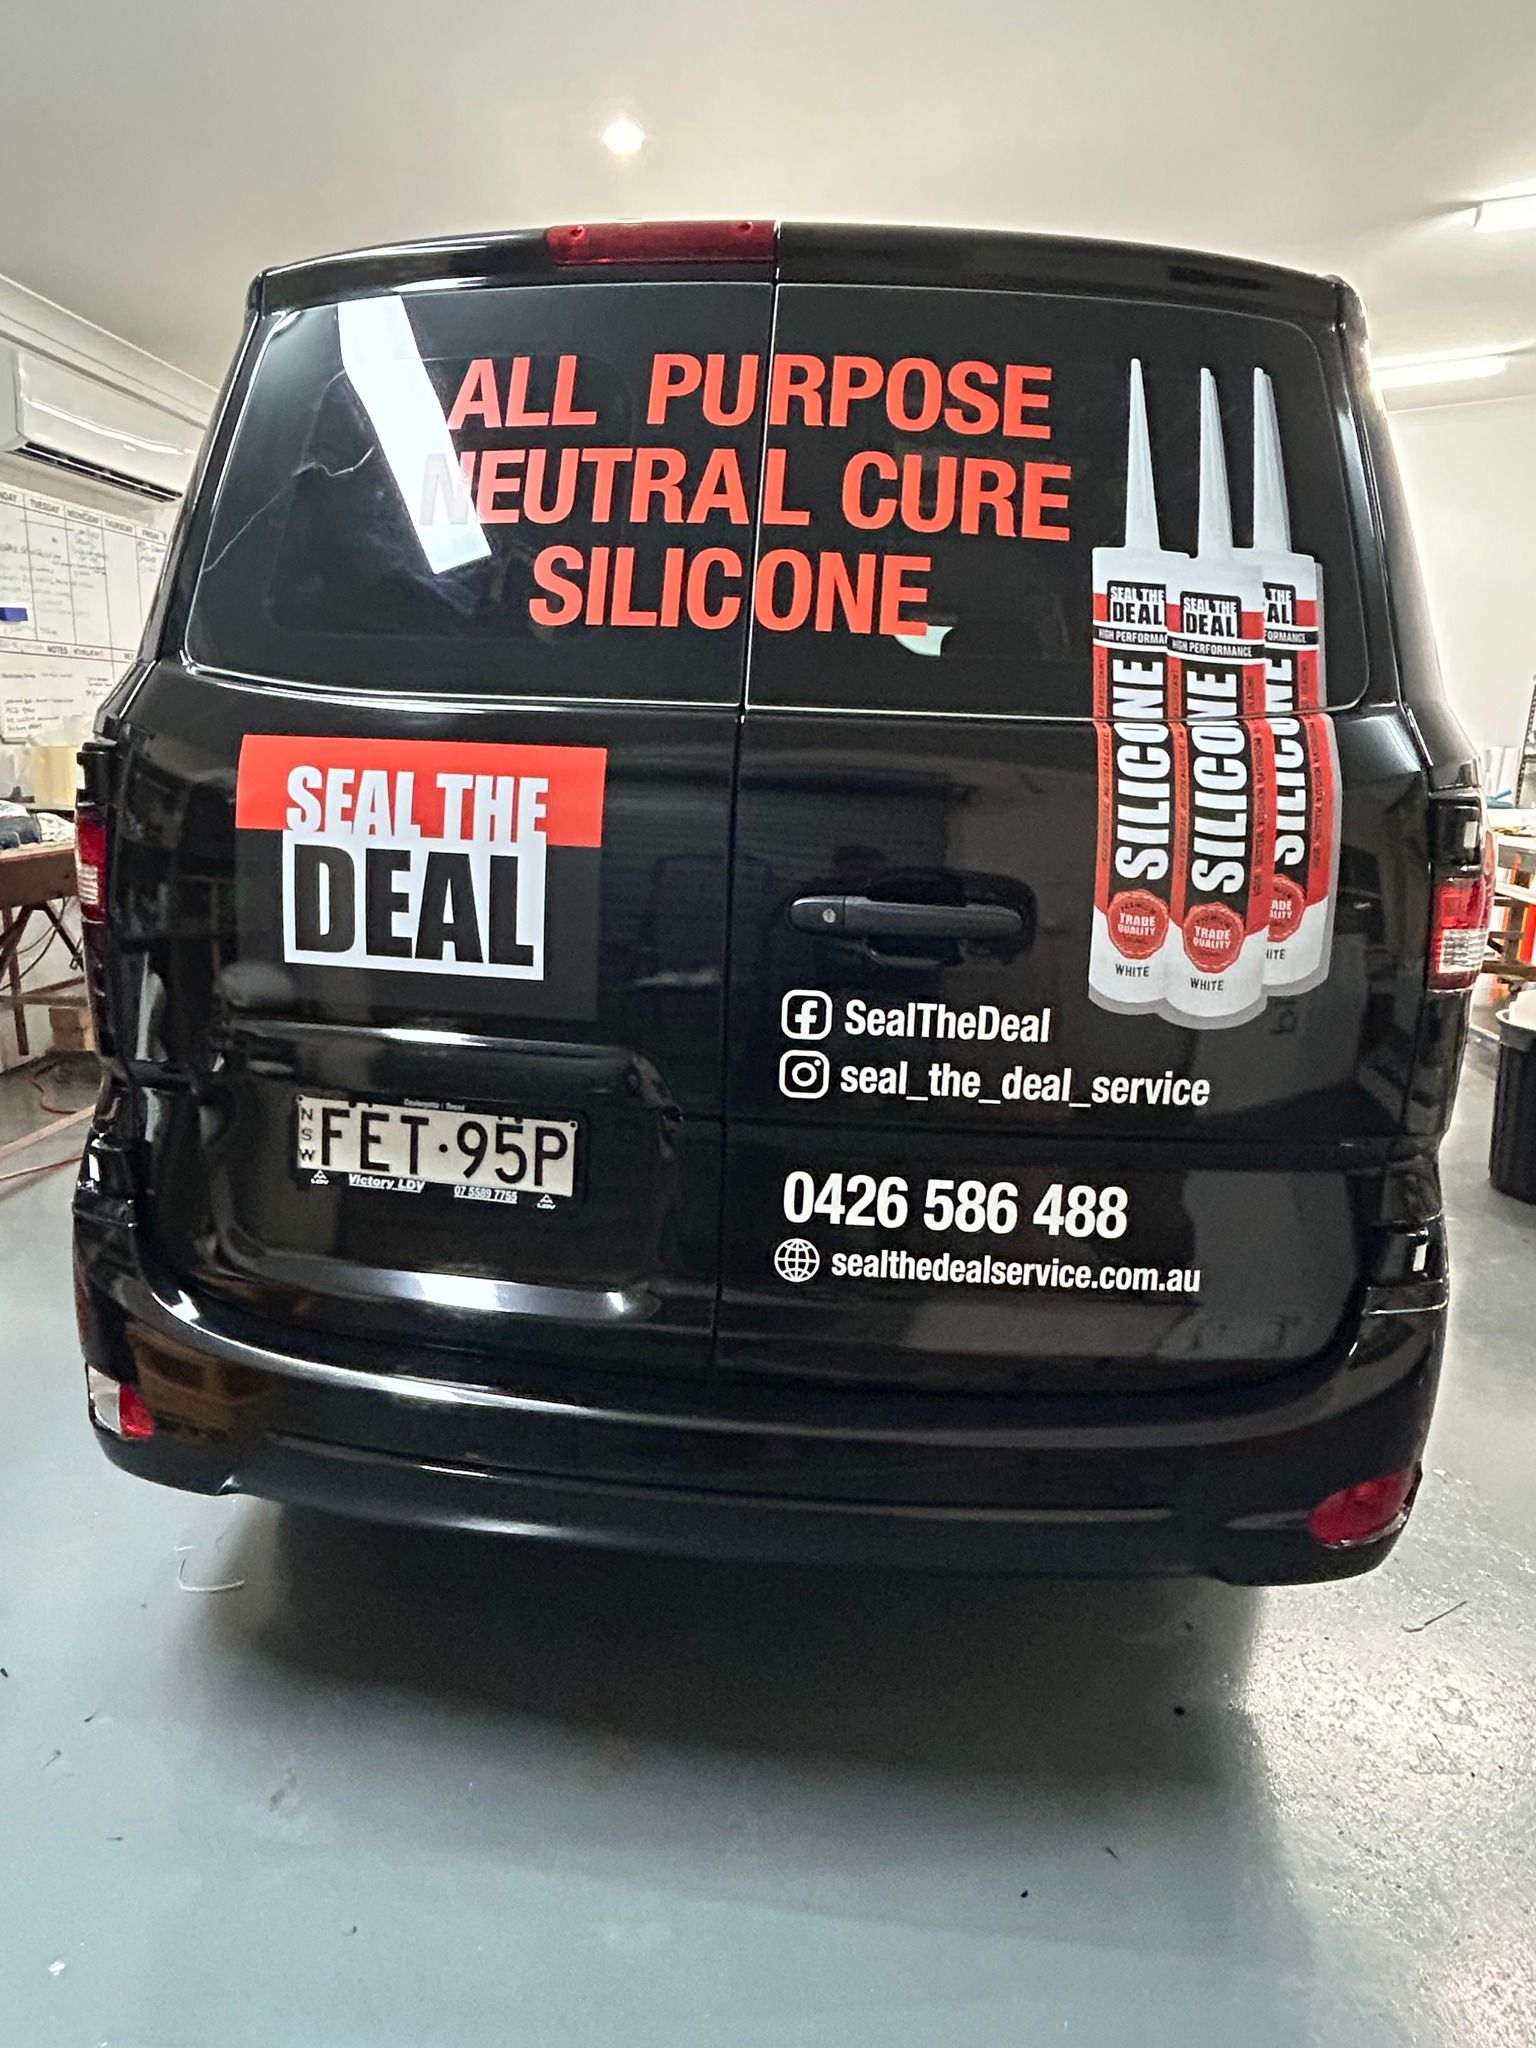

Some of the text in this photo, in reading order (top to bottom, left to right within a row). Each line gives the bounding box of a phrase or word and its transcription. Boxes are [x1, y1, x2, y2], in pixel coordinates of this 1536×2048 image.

[447, 353, 1053, 440] ALL PURPOSE
[419, 448, 1072, 542] NEUTRAL CURE
[529, 544, 932, 637] SILICONE
[1111, 585, 1165, 604] SEAL THE
[1269, 588, 1292, 603] THE
[1112, 601, 1163, 625] DEAL
[1183, 596, 1237, 614] SEAL THE
[1267, 603, 1290, 624] AL
[1099, 628, 1115, 640] HIGH
[1185, 613, 1235, 637] DEAL
[1264, 631, 1306, 644] FORMANCE
[1172, 639, 1252, 657] HIGH PERFORMANCE
[1112, 658, 1171, 880] SILICONE
[1265, 657, 1307, 866] SILICONE
[1186, 670, 1248, 894] SILICONE
[286, 765, 550, 843] SEAL THE
[293, 843, 535, 968] DEAL
[1271, 899, 1293, 911] ADE
[1117, 922, 1156, 936] QUALITY
[1119, 912, 1156, 926] TRADE
[1192, 936, 1231, 949] QUALITY
[1194, 925, 1231, 940] TRADE
[1115, 963, 1150, 978] WHITE
[1190, 977, 1225, 992] WHITE
[844, 999, 1051, 1043] SealTheDeal
[840, 1060, 1211, 1108] seal_the_deal_service
[349, 1173, 426, 1193] Victory LDV
[454, 1185, 467, 1198] 07
[493, 1190, 518, 1204] 7755
[782, 1170, 1129, 1240] 0426 586 488
[831, 1248, 1201, 1293] sealthedealservice.com.au
